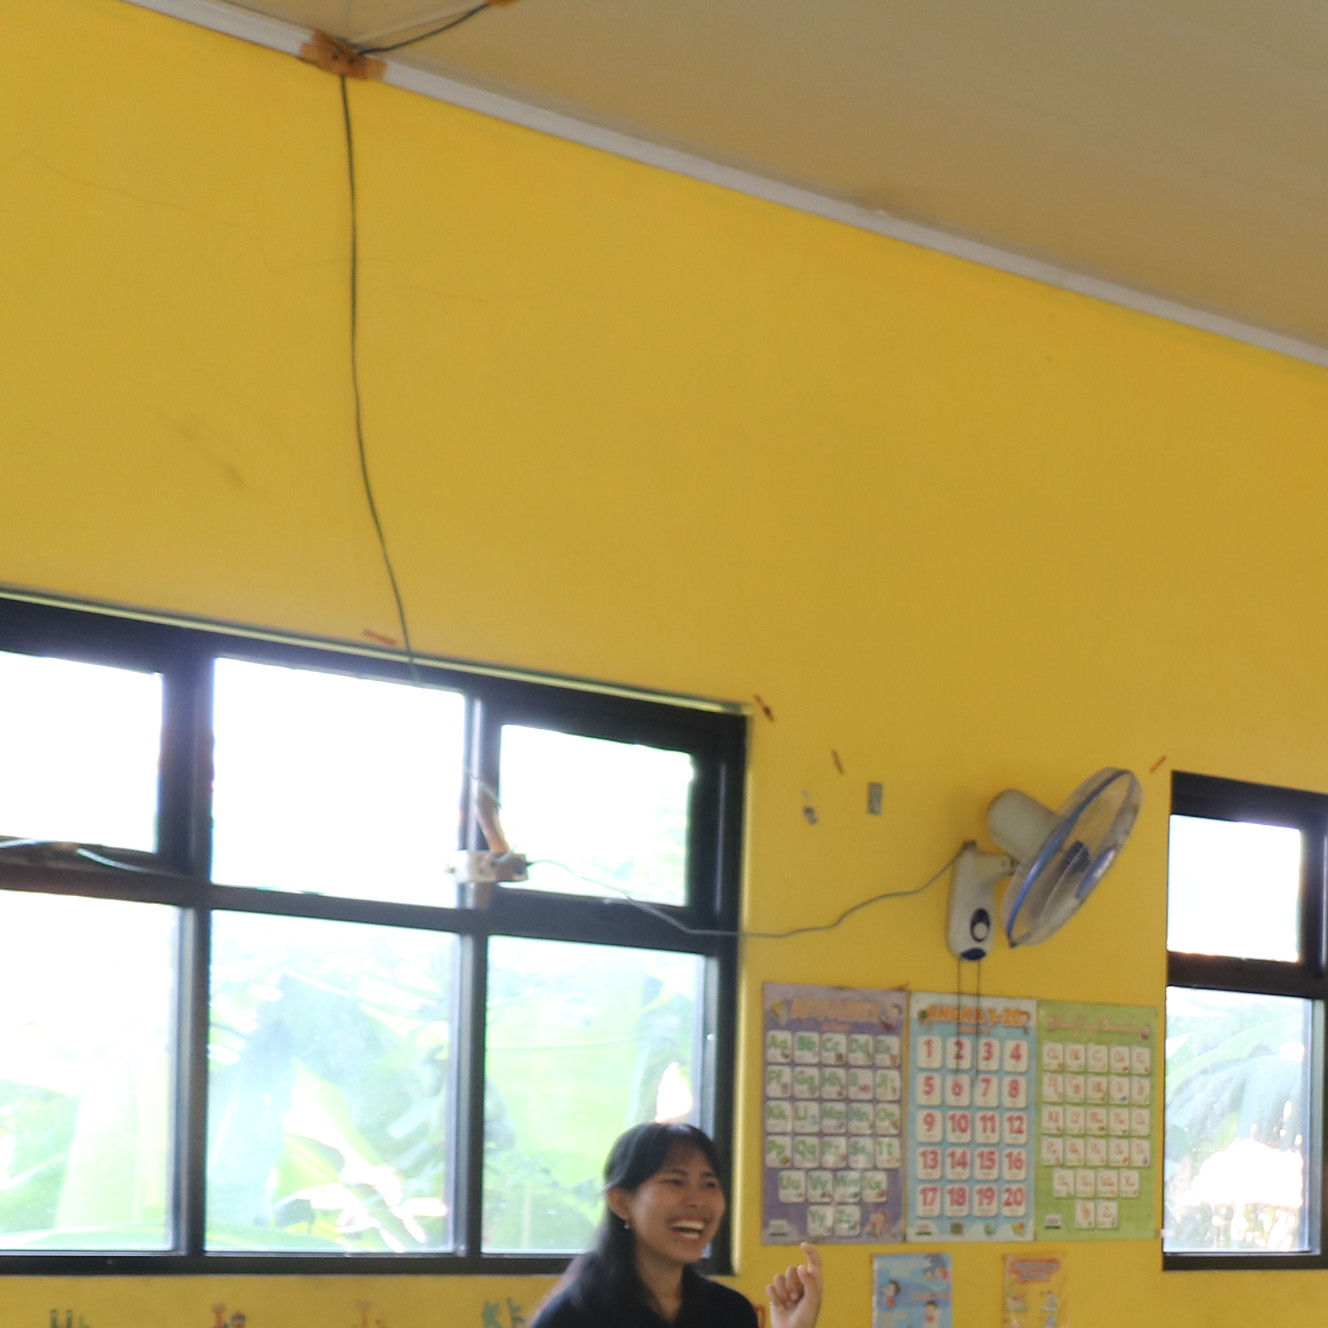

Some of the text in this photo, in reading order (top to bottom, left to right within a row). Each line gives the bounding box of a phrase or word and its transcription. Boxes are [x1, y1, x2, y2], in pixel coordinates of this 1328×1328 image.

[923, 1038, 1022, 1062] 1 2 3 4
[923, 1074, 1019, 1099] 5 6 7 8
[923, 1112, 935, 1132] 9
[948, 1113, 969, 1133] 10
[979, 1114, 996, 1133] 11
[1006, 1114, 1024, 1134] 12
[919, 1149, 1023, 1171] 13 14 15 16
[919, 1186, 1024, 1207] 17 18 19 20
